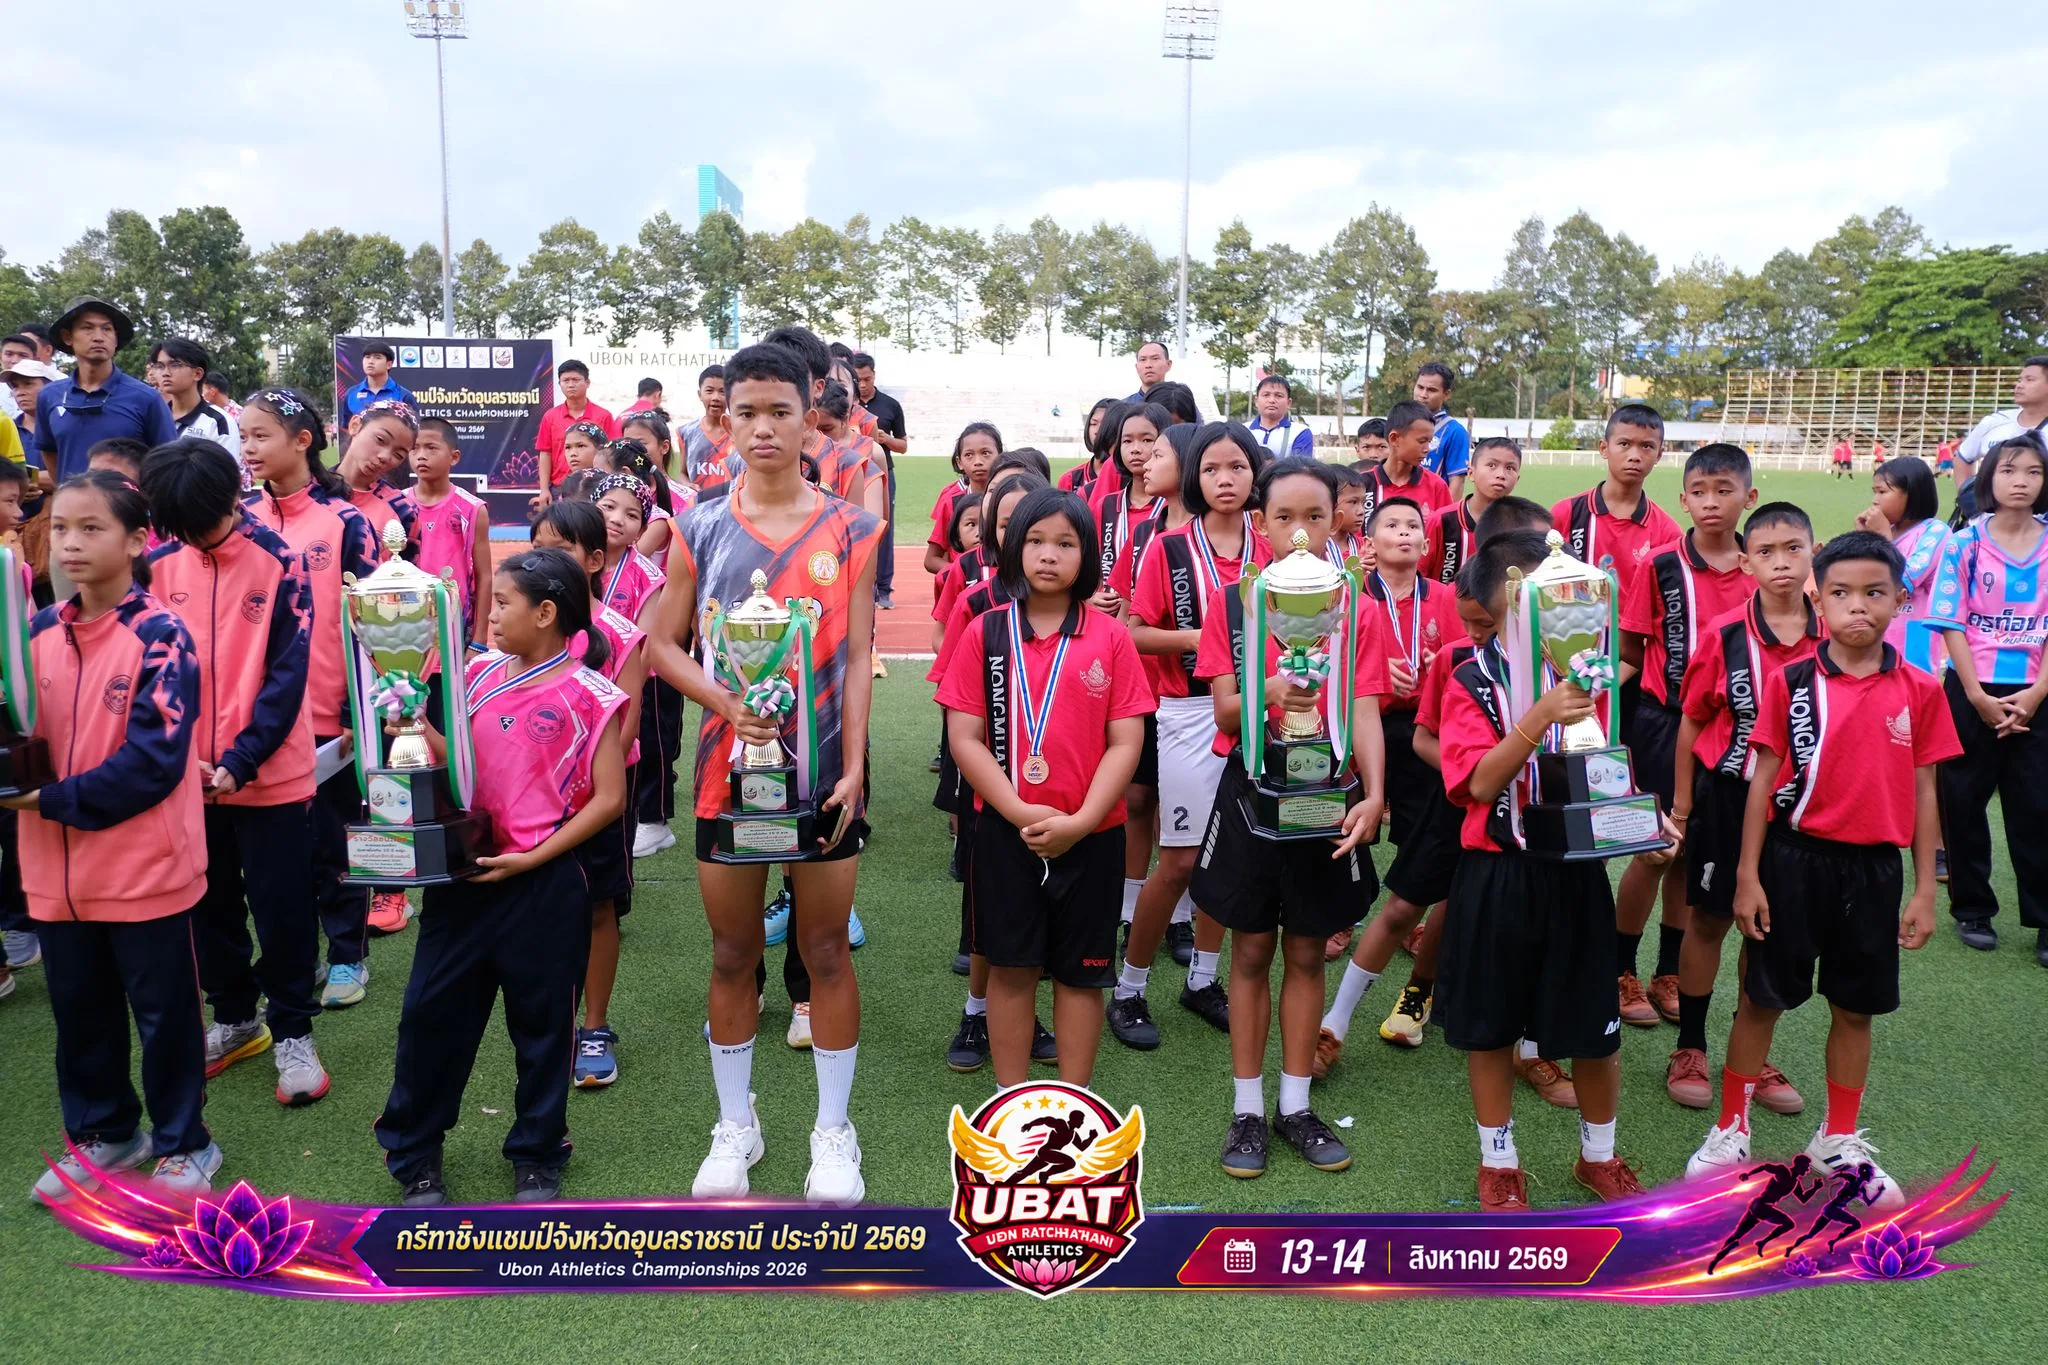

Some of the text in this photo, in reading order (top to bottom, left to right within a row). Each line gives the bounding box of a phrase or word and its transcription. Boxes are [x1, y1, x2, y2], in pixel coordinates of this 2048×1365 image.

[590, 352, 633, 365] UBON
[420, 409, 452, 417] LETICS
[1983, 572, 1995, 593] 9
[1174, 806, 1190, 832] 2
[1082, 958, 1111, 967] SPORT
